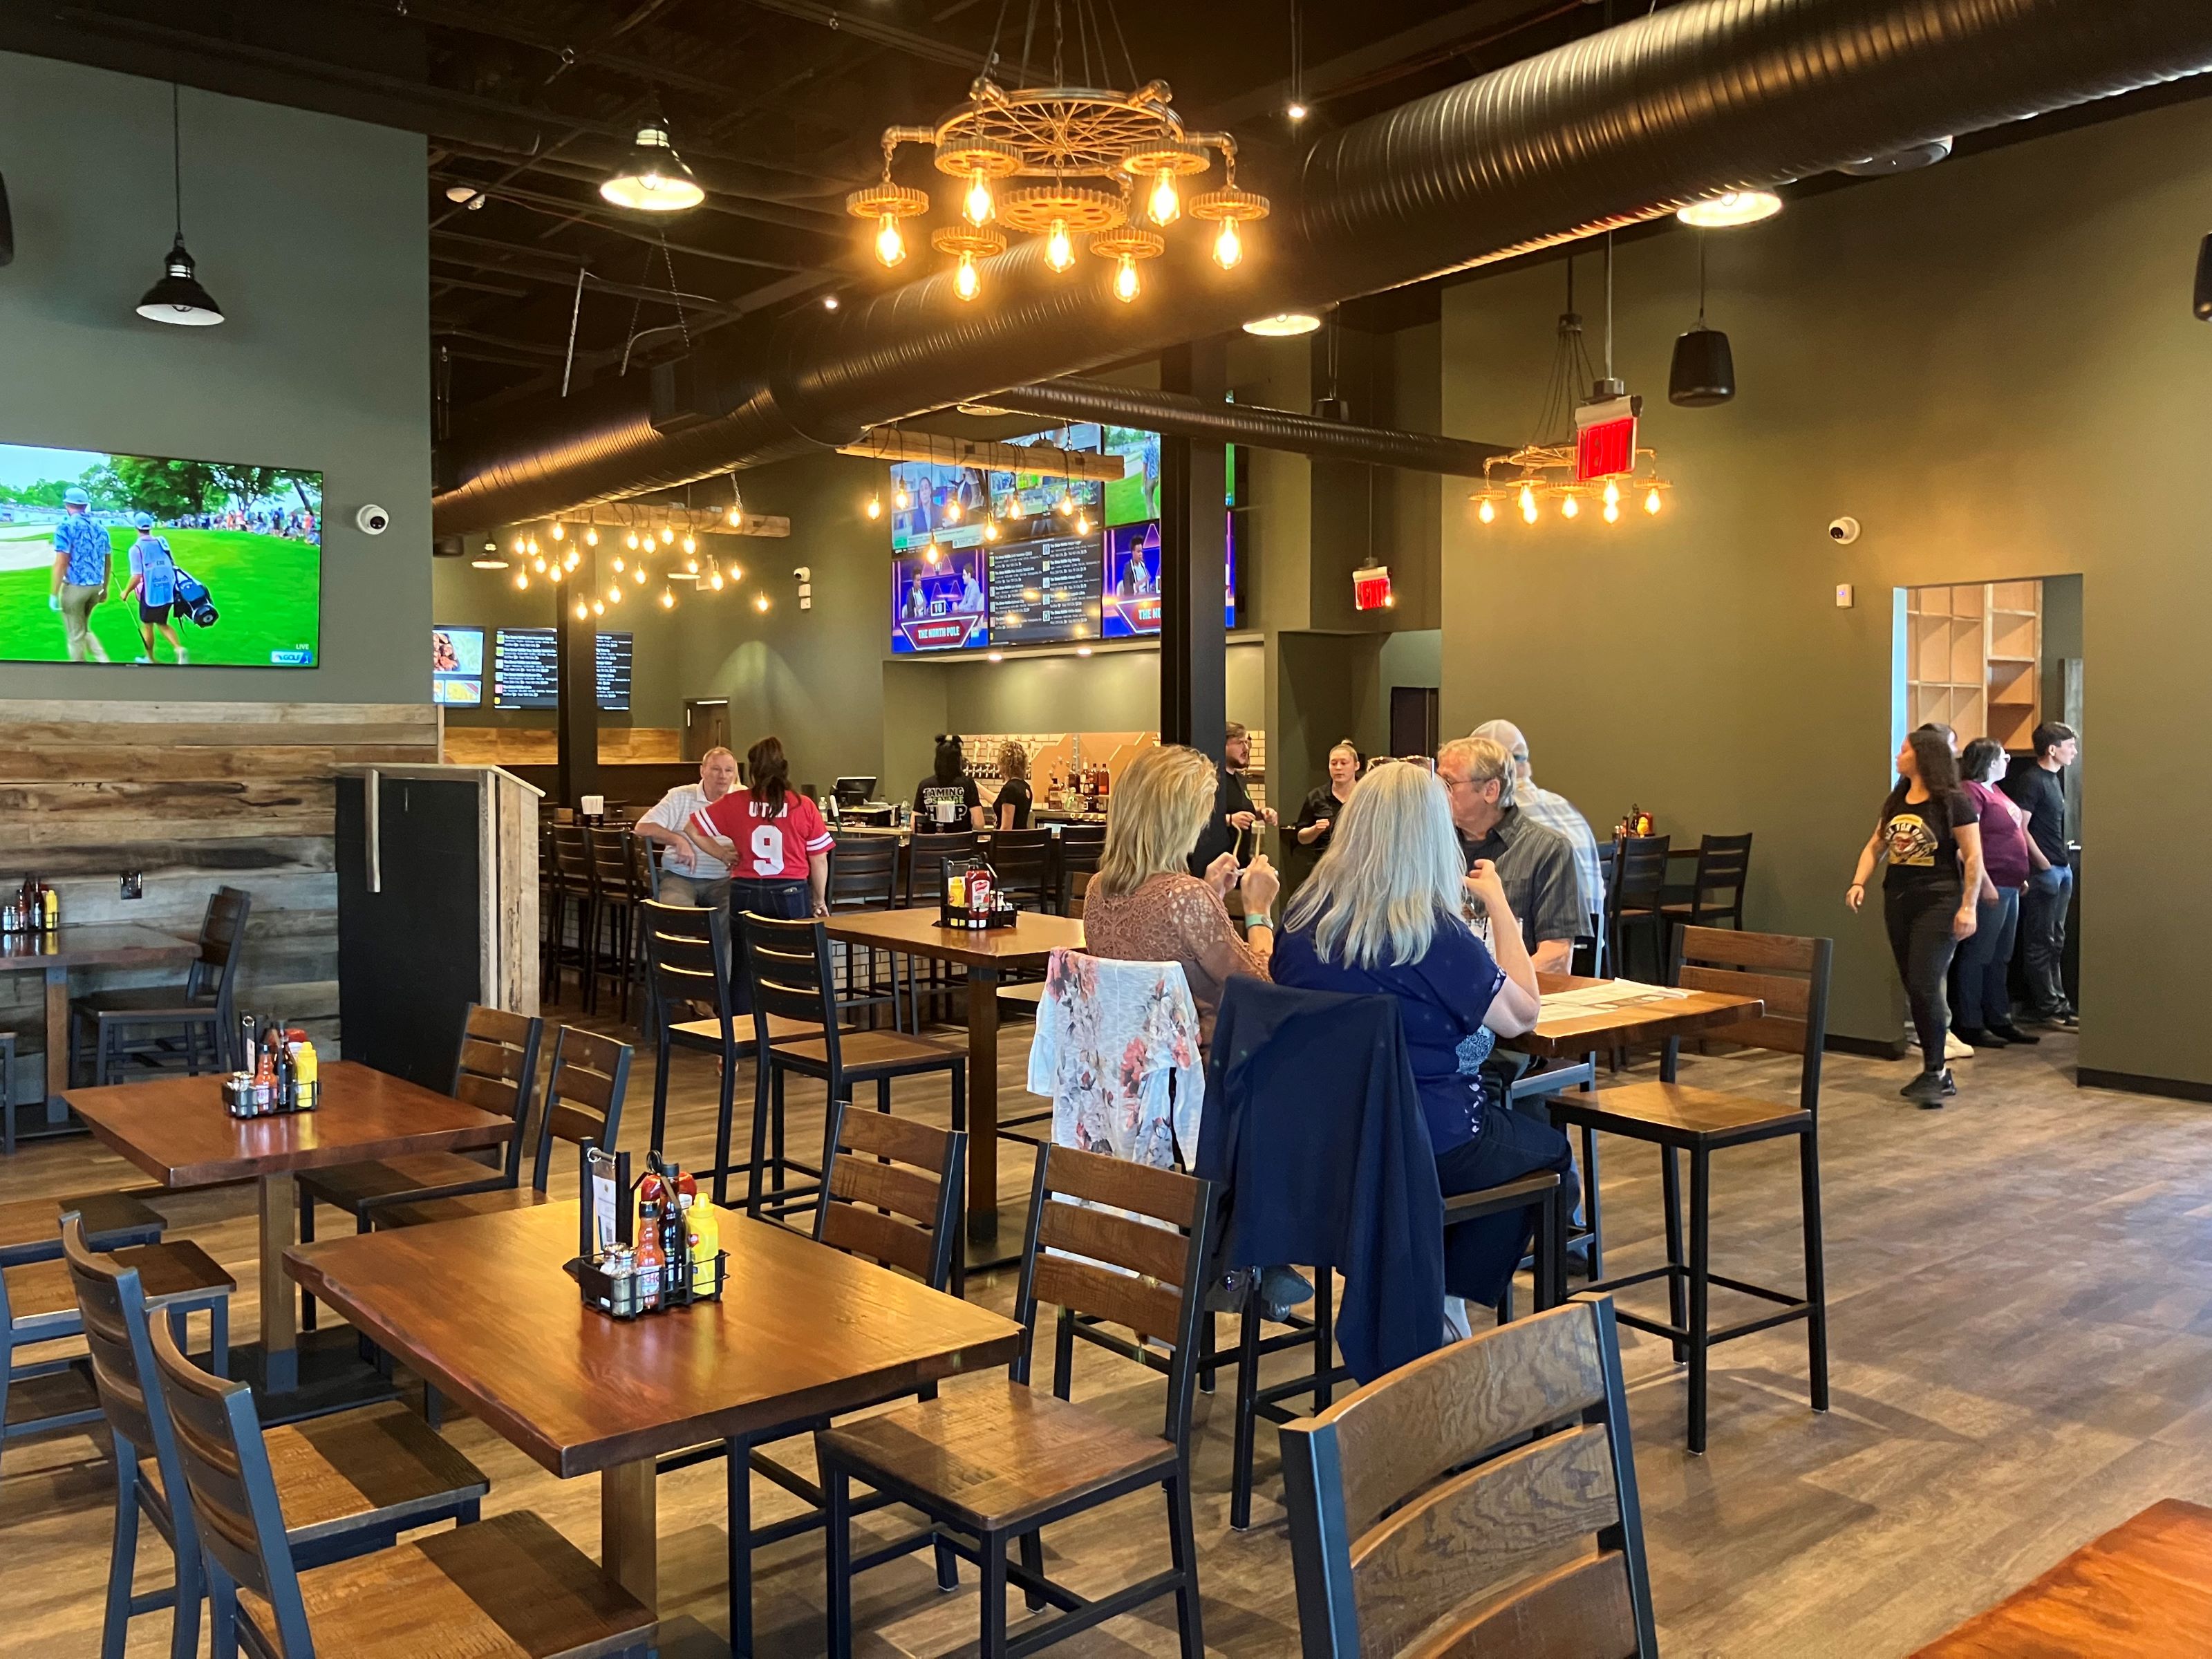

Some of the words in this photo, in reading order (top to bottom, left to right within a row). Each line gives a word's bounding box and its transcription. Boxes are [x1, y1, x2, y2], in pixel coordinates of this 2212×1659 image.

[1586, 421, 1629, 477] EXIT
[1138, 609, 1151, 619] THE
[918, 630, 928, 639] THE
[928, 628, 946, 637] NORTH
[947, 626, 959, 636] POLE
[923, 787, 965, 798] TAMING
[926, 804, 968, 822] HP
[751, 825, 785, 877] 9
